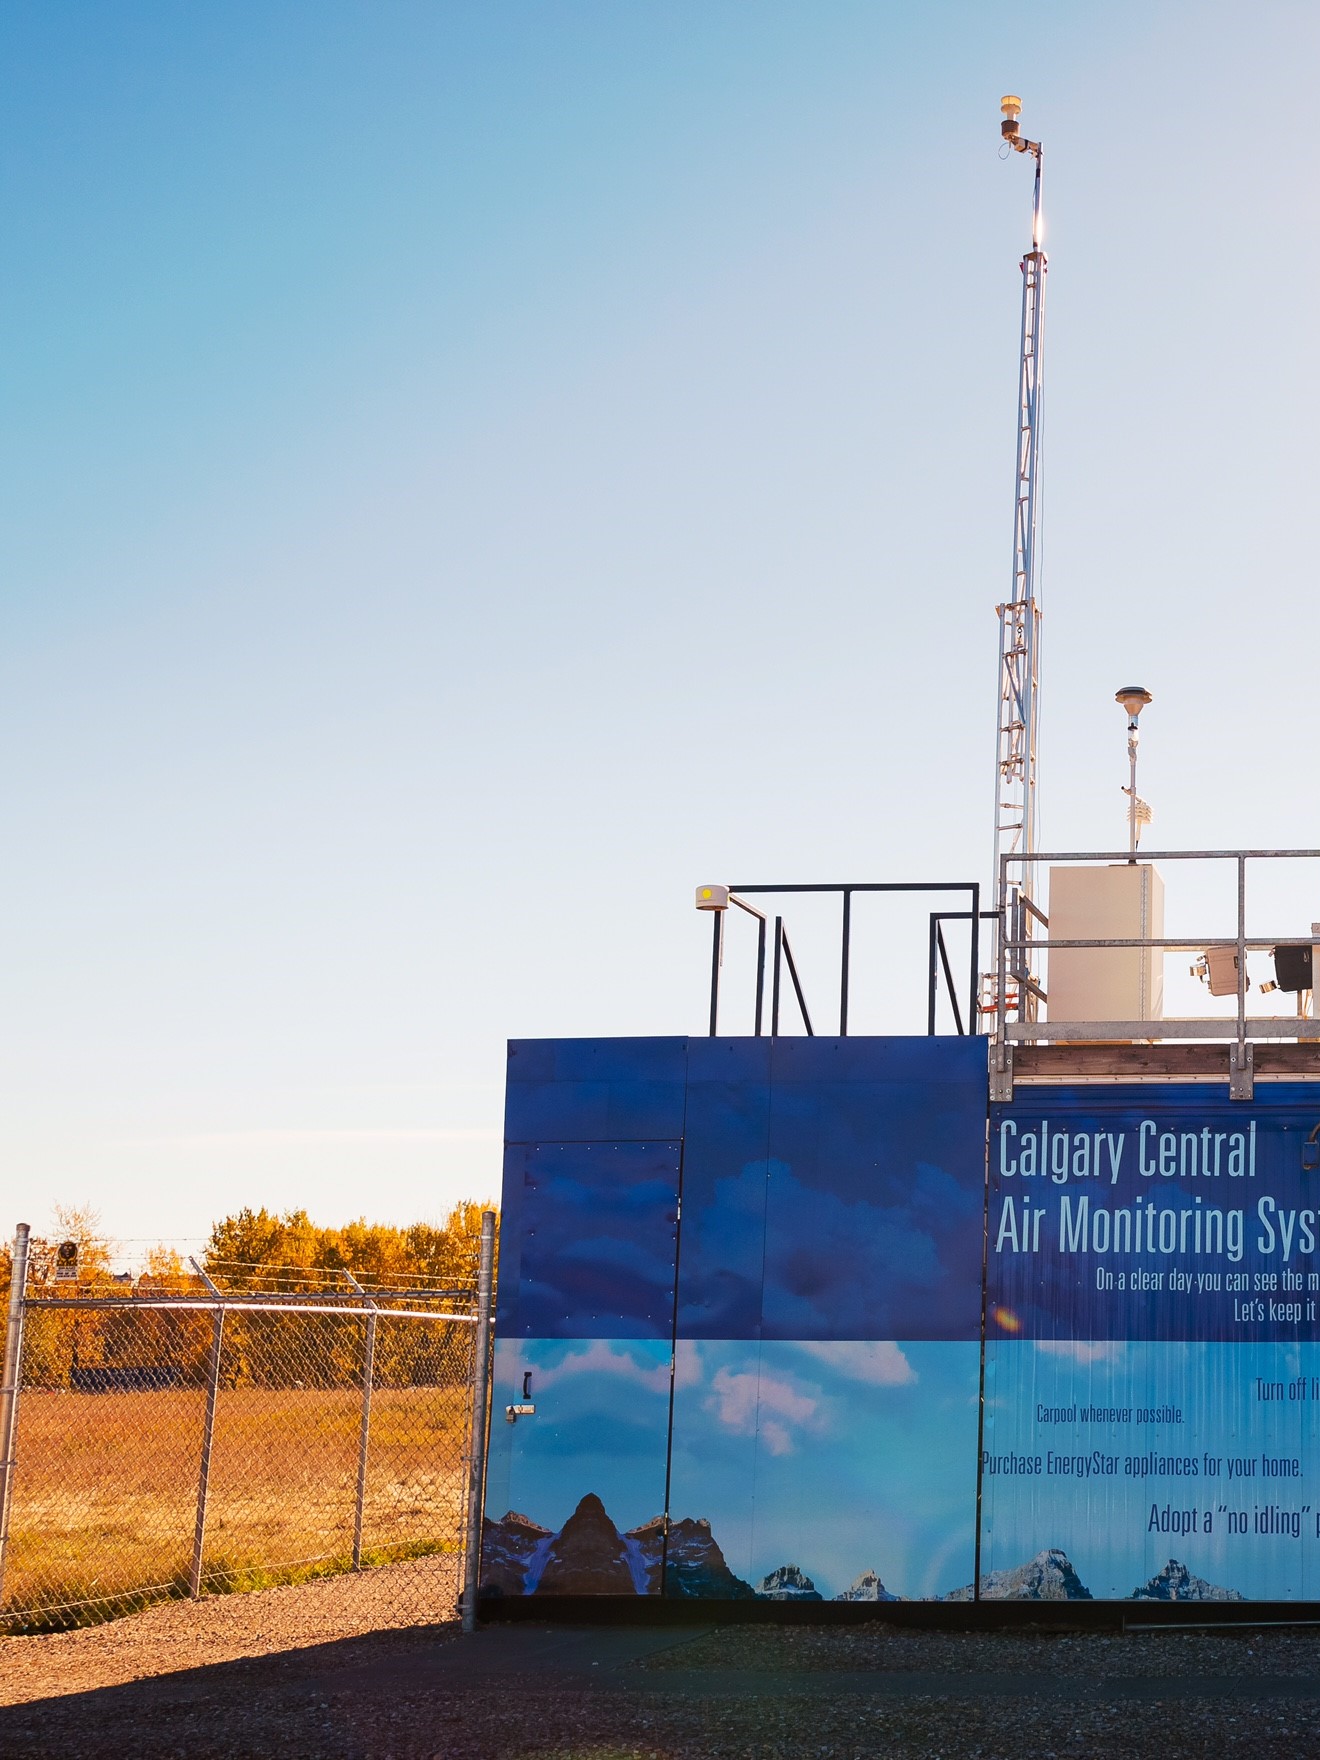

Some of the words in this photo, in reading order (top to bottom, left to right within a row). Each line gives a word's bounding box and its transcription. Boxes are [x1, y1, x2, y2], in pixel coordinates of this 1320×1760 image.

[1000, 1120, 1125, 1184] Calgary
[1139, 1120, 1257, 1177] Central
[995, 1195, 1046, 1253] Air
[1059, 1195, 1244, 1262] Monitoring
[1096, 1266, 1114, 1290] On
[1115, 1272, 1125, 1290] a
[1130, 1267, 1164, 1290] clear
[1169, 1268, 1192, 1294] day
[1197, 1272, 1221, 1294] you
[1226, 1272, 1250, 1291] can
[1254, 1272, 1277, 1291] see
[1282, 1268, 1303, 1291] the
[1234, 1298, 1265, 1322] Let's
[1269, 1299, 1302, 1324] keep
[1306, 1299, 1315, 1321] it
[1256, 1377, 1284, 1401] Turn
[1288, 1377, 1307, 1401] off
[1037, 1404, 1077, 1424] Carpool
[1080, 1405, 1132, 1424] whenever
[1136, 1405, 1185, 1425] possible.
[981, 1451, 1042, 1475] Purchase
[1047, 1451, 1119, 1478] EnergyStar
[1124, 1453, 1199, 1479] appliances
[1203, 1453, 1222, 1476] for
[1227, 1459, 1256, 1479] your
[1262, 1454, 1303, 1477] home.
[1148, 1504, 1198, 1537] Adopt
[1203, 1512, 1213, 1534] a
